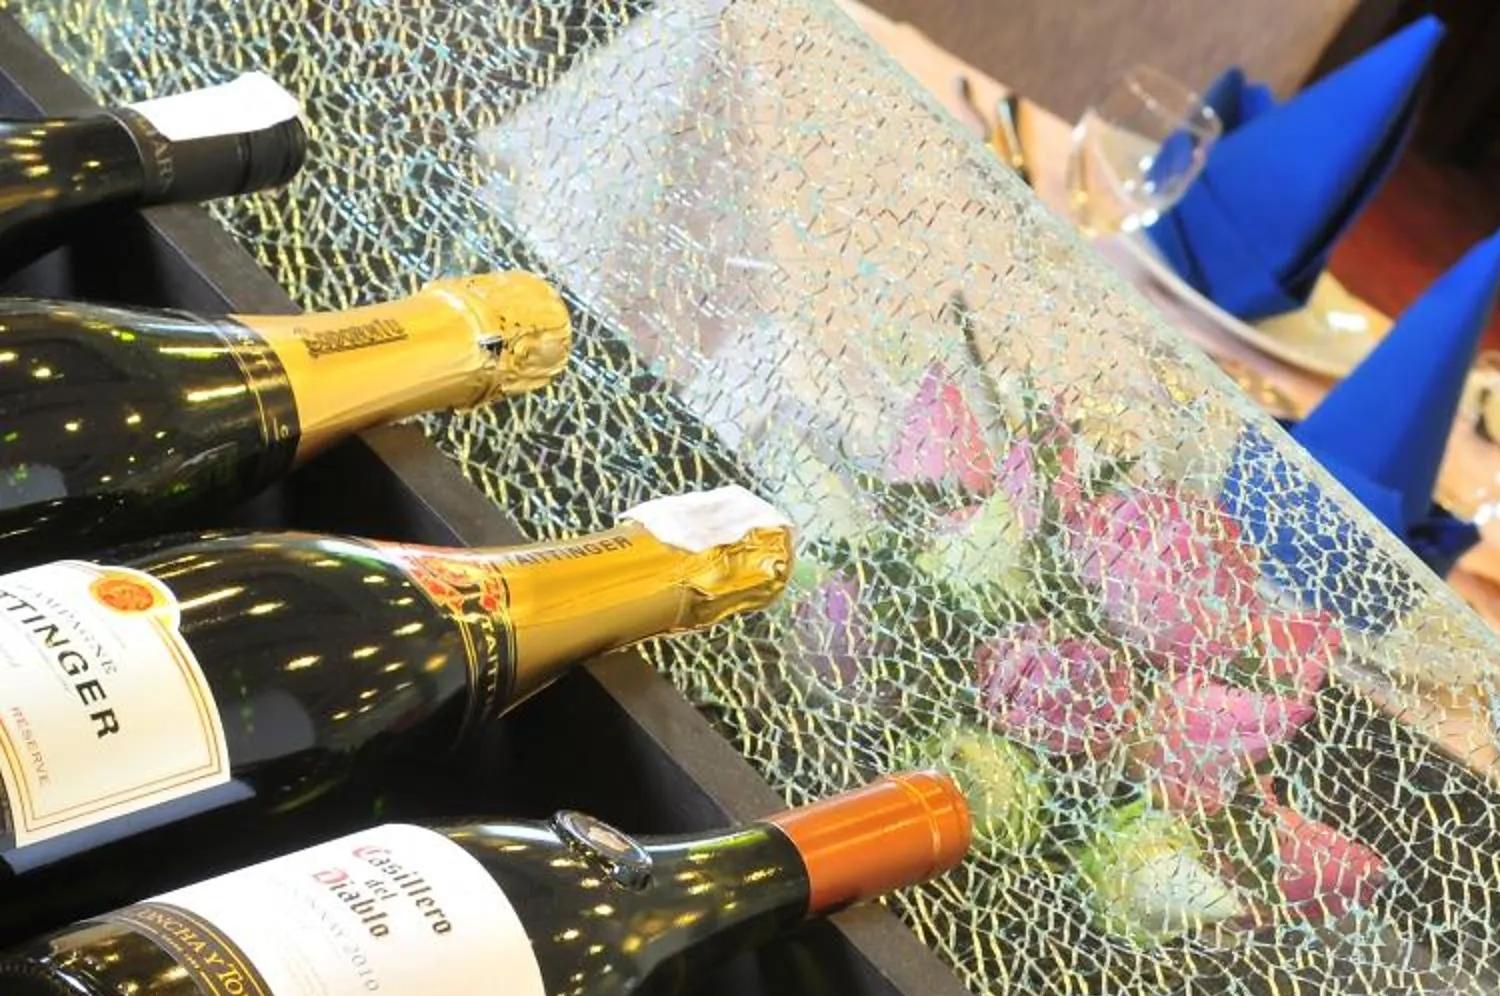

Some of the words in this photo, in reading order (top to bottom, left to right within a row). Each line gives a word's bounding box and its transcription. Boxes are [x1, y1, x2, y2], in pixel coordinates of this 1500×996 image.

[508, 535, 633, 567] TAITTINGER
[20, 586, 117, 674] AMPAGNE
[12, 706, 50, 785] RESERVE
[312, 867, 389, 940] Diablo
[352, 844, 453, 935] Casillero
[364, 878, 398, 902] del
